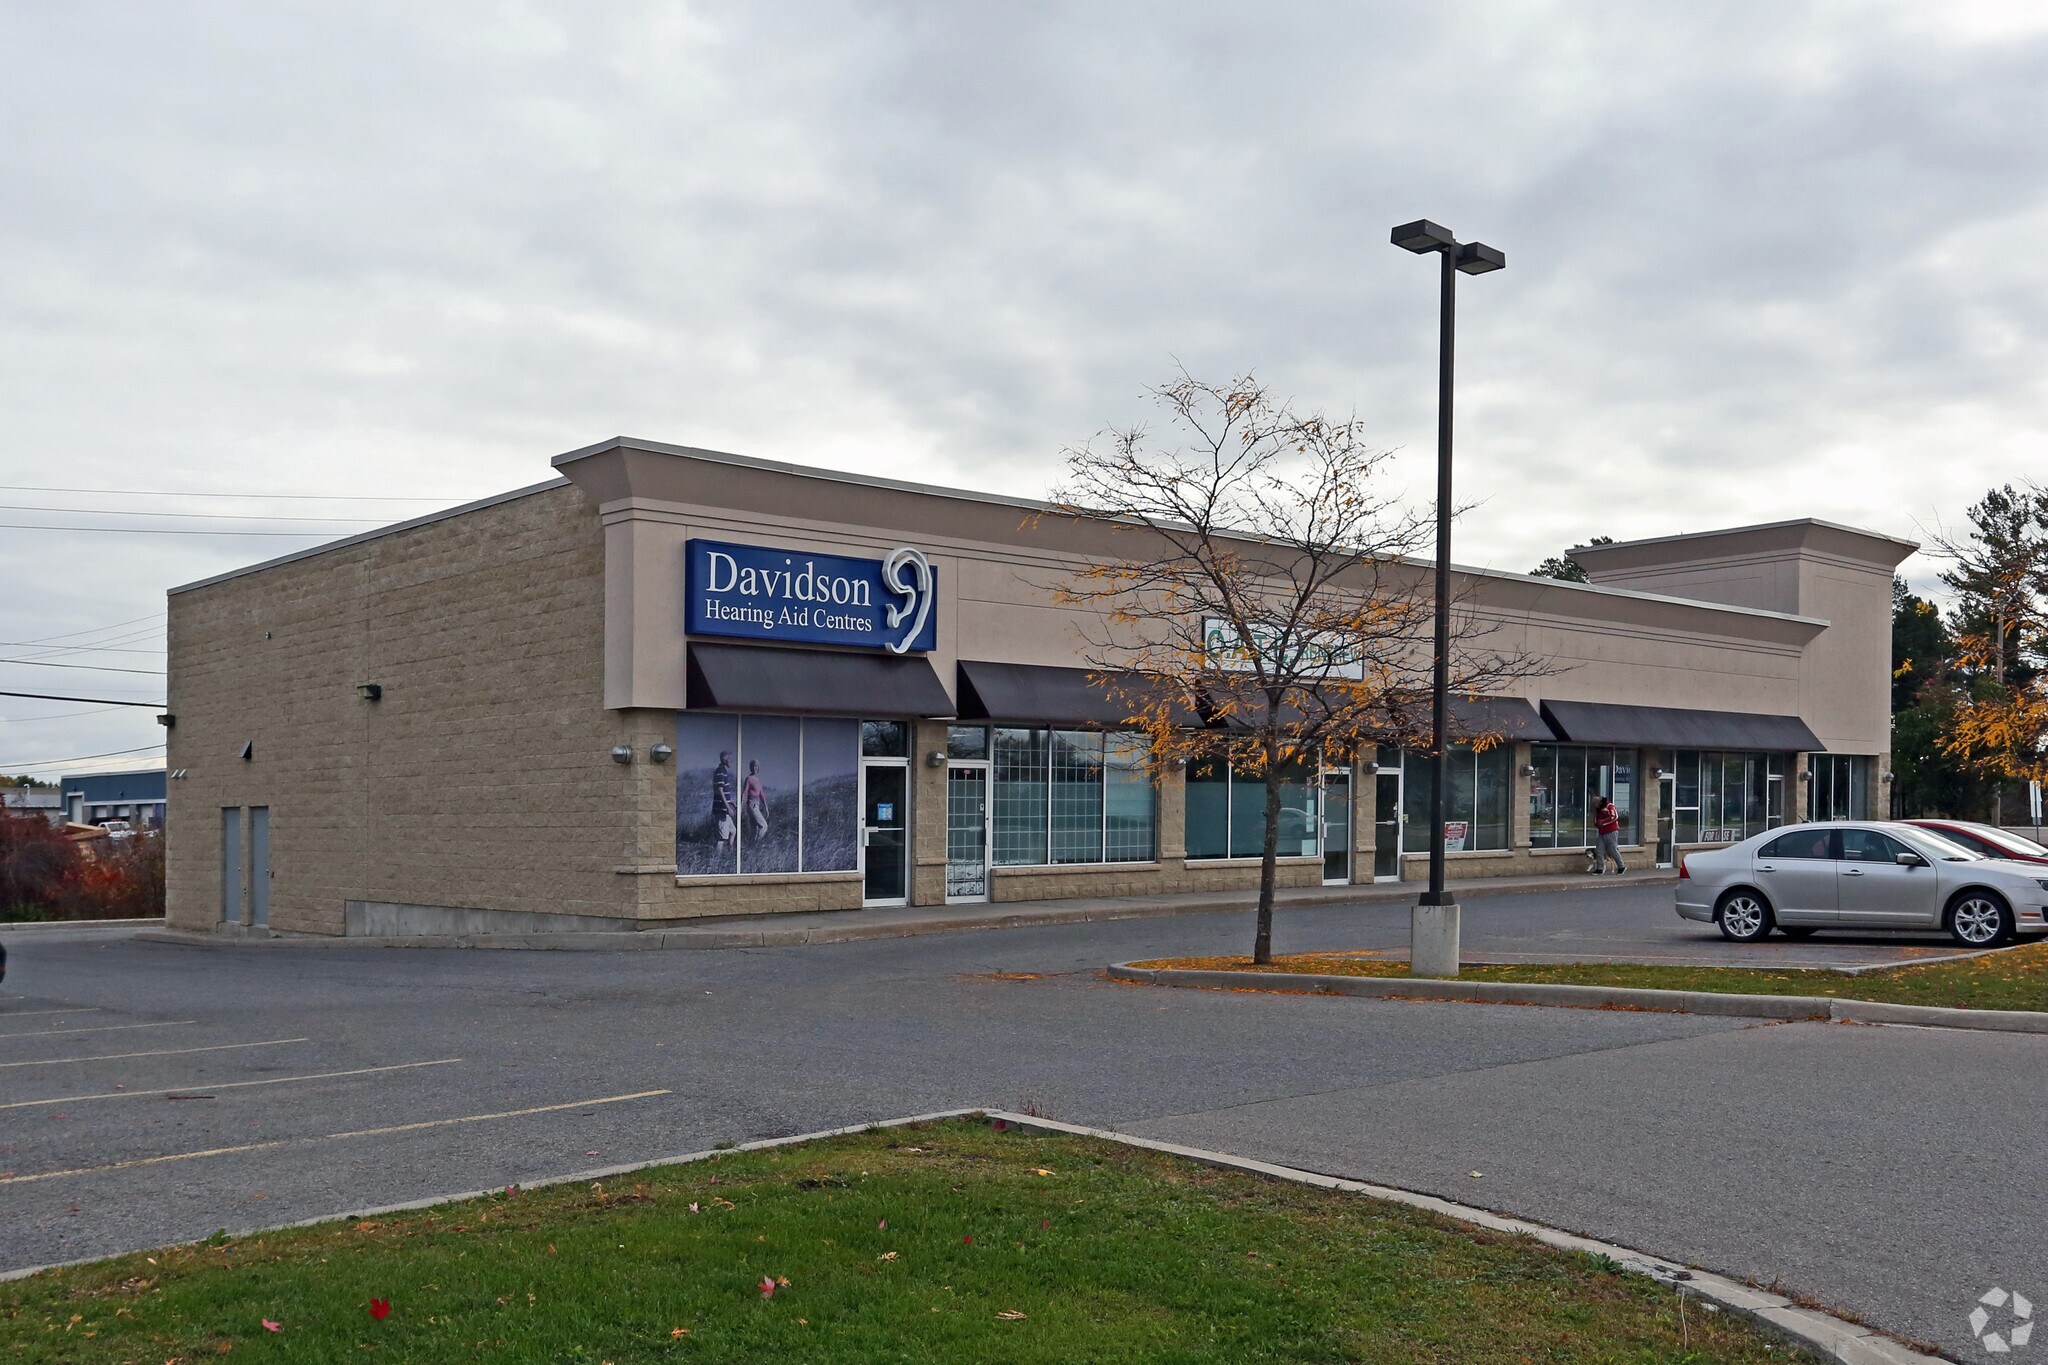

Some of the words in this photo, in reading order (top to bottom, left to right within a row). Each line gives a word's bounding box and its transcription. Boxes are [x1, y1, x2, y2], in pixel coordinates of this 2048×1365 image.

[706, 551, 872, 607] Davidson
[705, 599, 774, 630] Hearing
[778, 606, 809, 627] Aid
[813, 608, 873, 632] Centres
[1704, 831, 1715, 841] FOR
[1715, 830, 1730, 841] LESE
